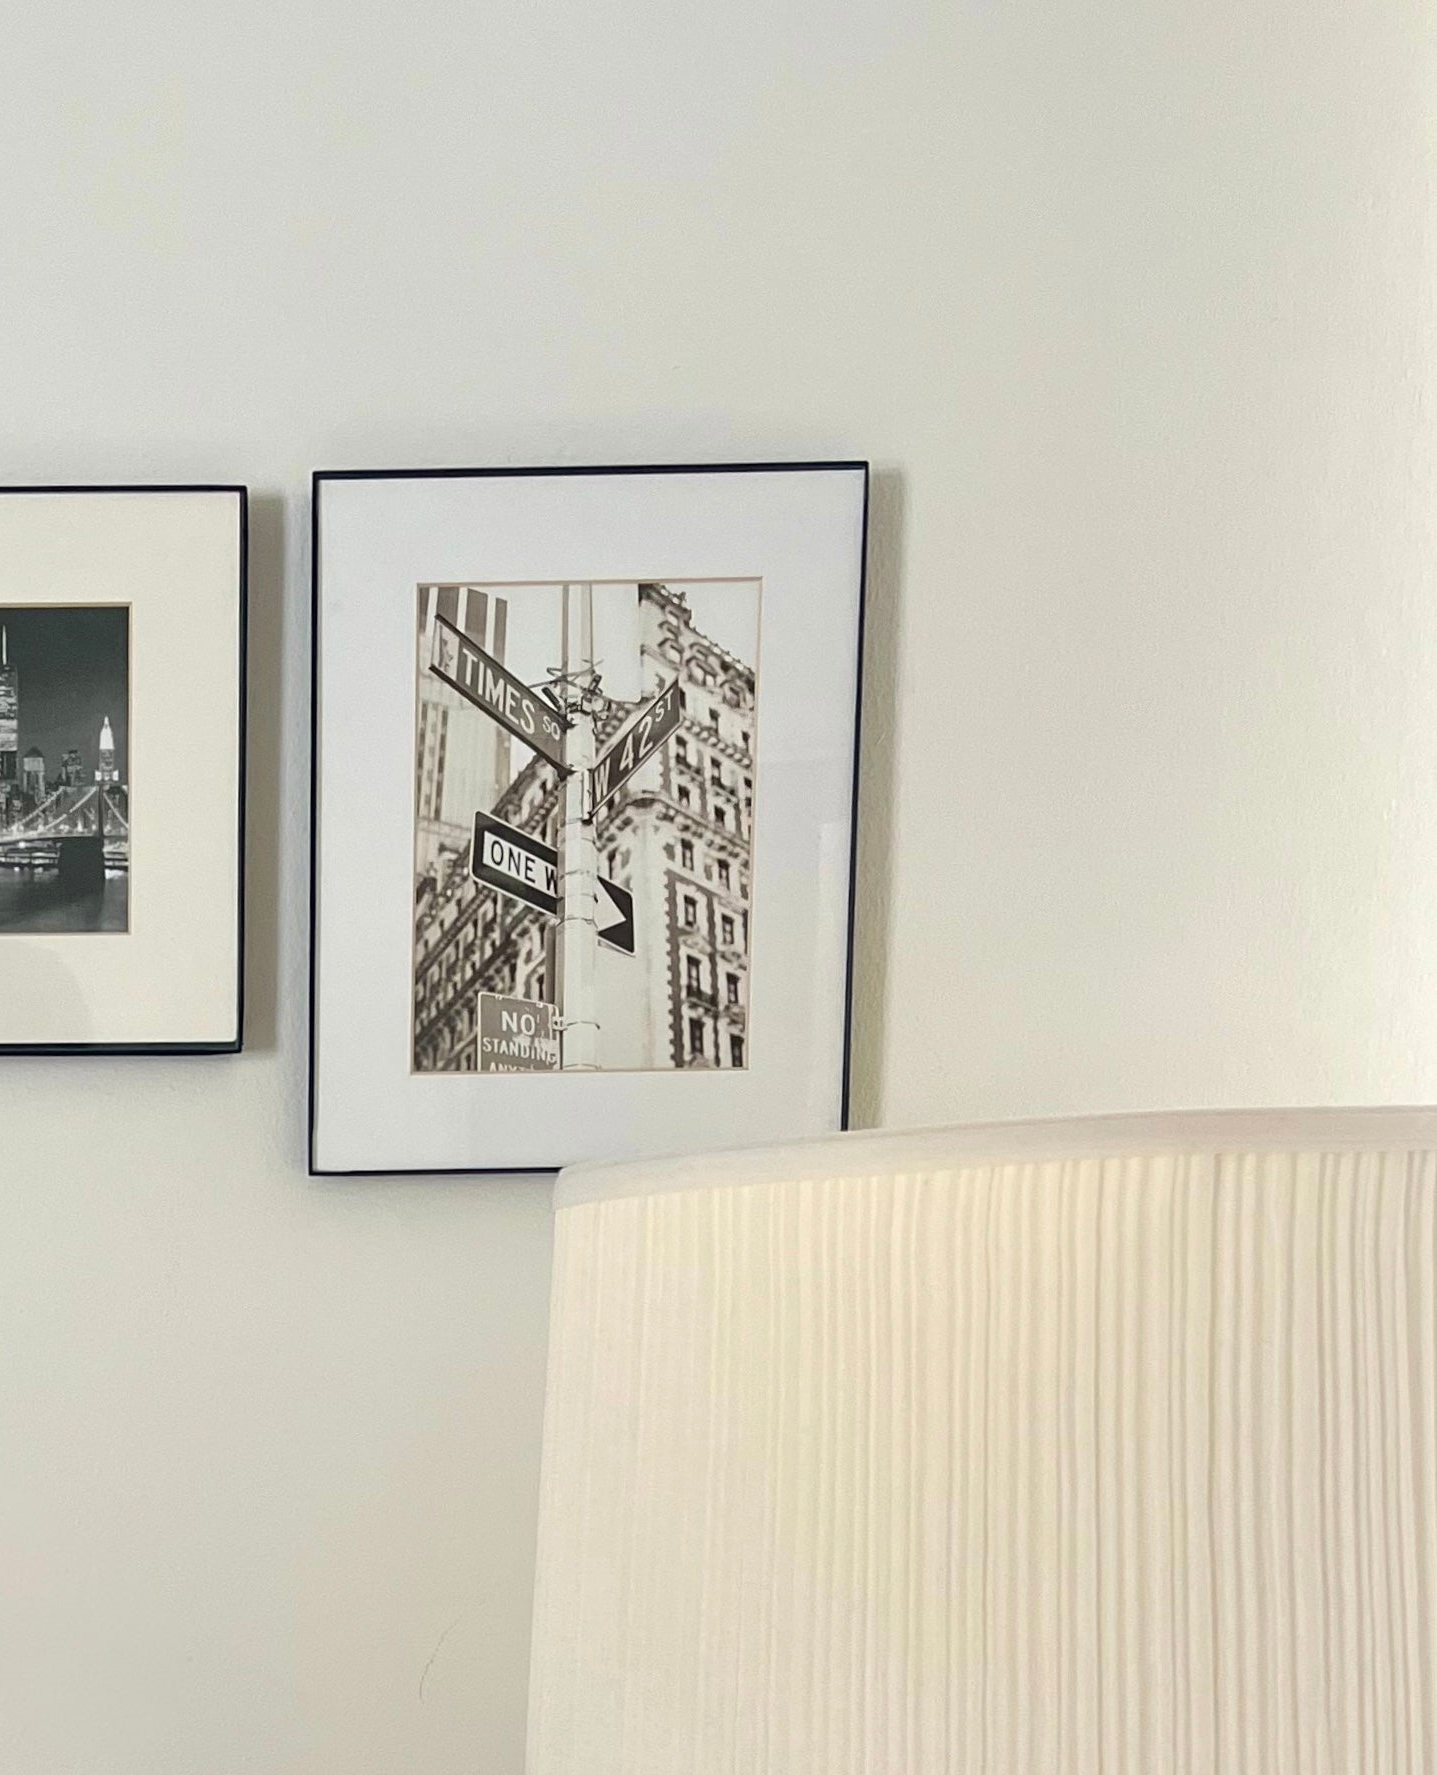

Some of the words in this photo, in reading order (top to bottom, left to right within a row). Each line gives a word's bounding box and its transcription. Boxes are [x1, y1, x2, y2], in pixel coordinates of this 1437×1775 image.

[463, 648, 536, 735] TIMES
[594, 756, 610, 803] W
[619, 715, 653, 771] 42
[491, 840, 536, 884] ONE
[501, 1010, 536, 1036] NO
